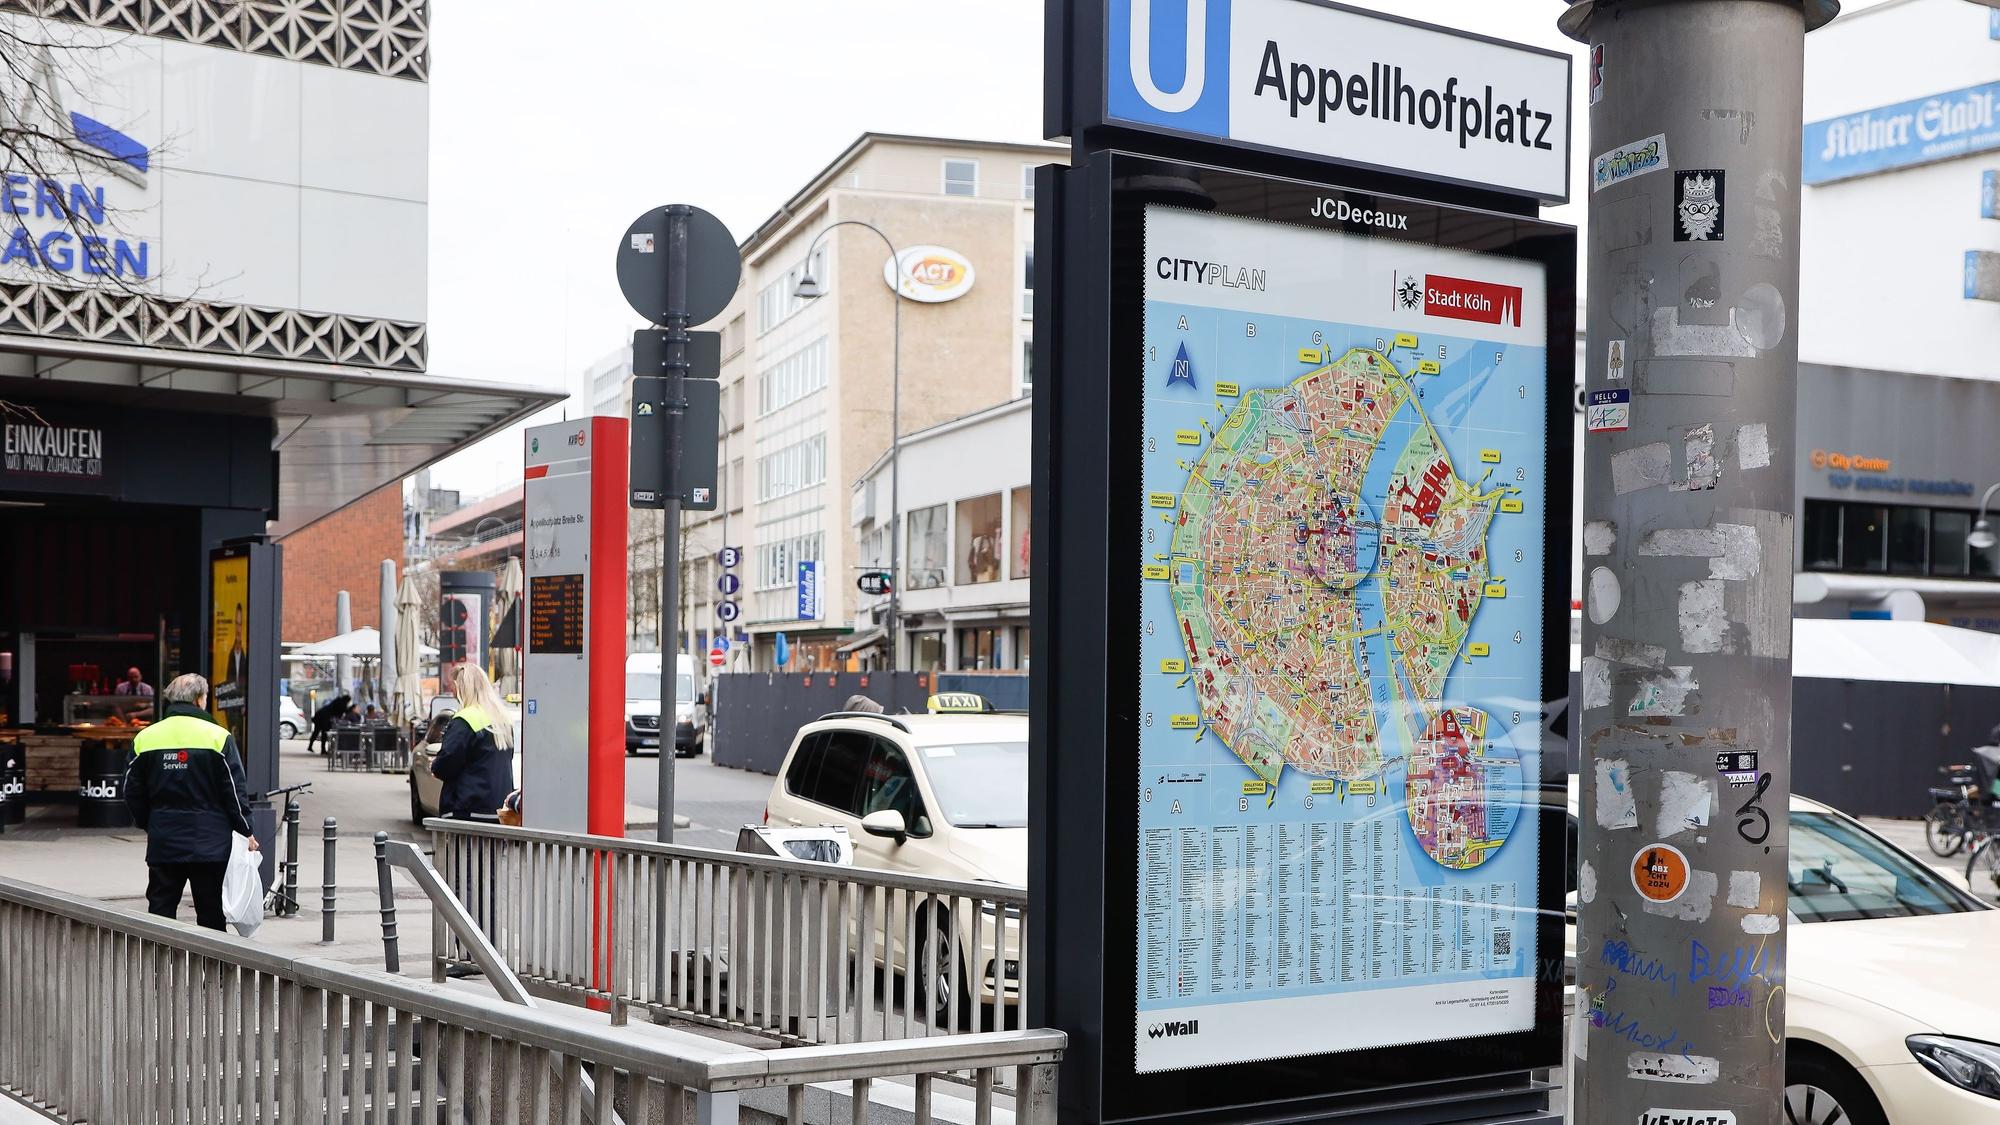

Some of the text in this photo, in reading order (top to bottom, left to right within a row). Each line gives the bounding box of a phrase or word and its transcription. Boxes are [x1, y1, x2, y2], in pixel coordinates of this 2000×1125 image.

[1129, 0, 1207, 114] U
[1254, 39, 1553, 151] Appellhofplatz
[1821, 111, 1913, 161] Kölner
[1310, 196, 1409, 231] JCDecaux
[912, 262, 954, 281] ACT
[1427, 287, 1492, 313] Stadt Köln
[1177, 314, 1189, 331] A
[1246, 322, 1257, 338] B
[1312, 330, 1322, 345] C
[1376, 337, 1386, 352] D
[1438, 345, 1446, 360] E
[1494, 352, 1503, 365] F
[1149, 346, 1156, 361] 1
[1174, 359, 1189, 378] N
[1518, 385, 1525, 399] 1
[1594, 391, 1618, 401] HELLO
[5, 424, 102, 459] EINKAUFEN
[1148, 438, 1156, 452] 2
[1828, 452, 1850, 472] City
[1516, 468, 1525, 481] 2
[1147, 529, 1155, 543] 3
[1515, 549, 1523, 562] 3
[1146, 620, 1154, 636] 4
[1513, 630, 1522, 643] 4
[940, 695, 977, 708] TAXI
[1145, 712, 1153, 727] 5
[1512, 711, 1521, 724] 5
[163, 752, 178, 761] KVB
[163, 761, 188, 770] Service
[1144, 788, 1152, 802] 6
[1170, 794, 1376, 814] A B C D
[1651, 864, 1669, 873] ABI
[1648, 880, 1670, 888] 2024
[1165, 1019, 1199, 1037] Wall
